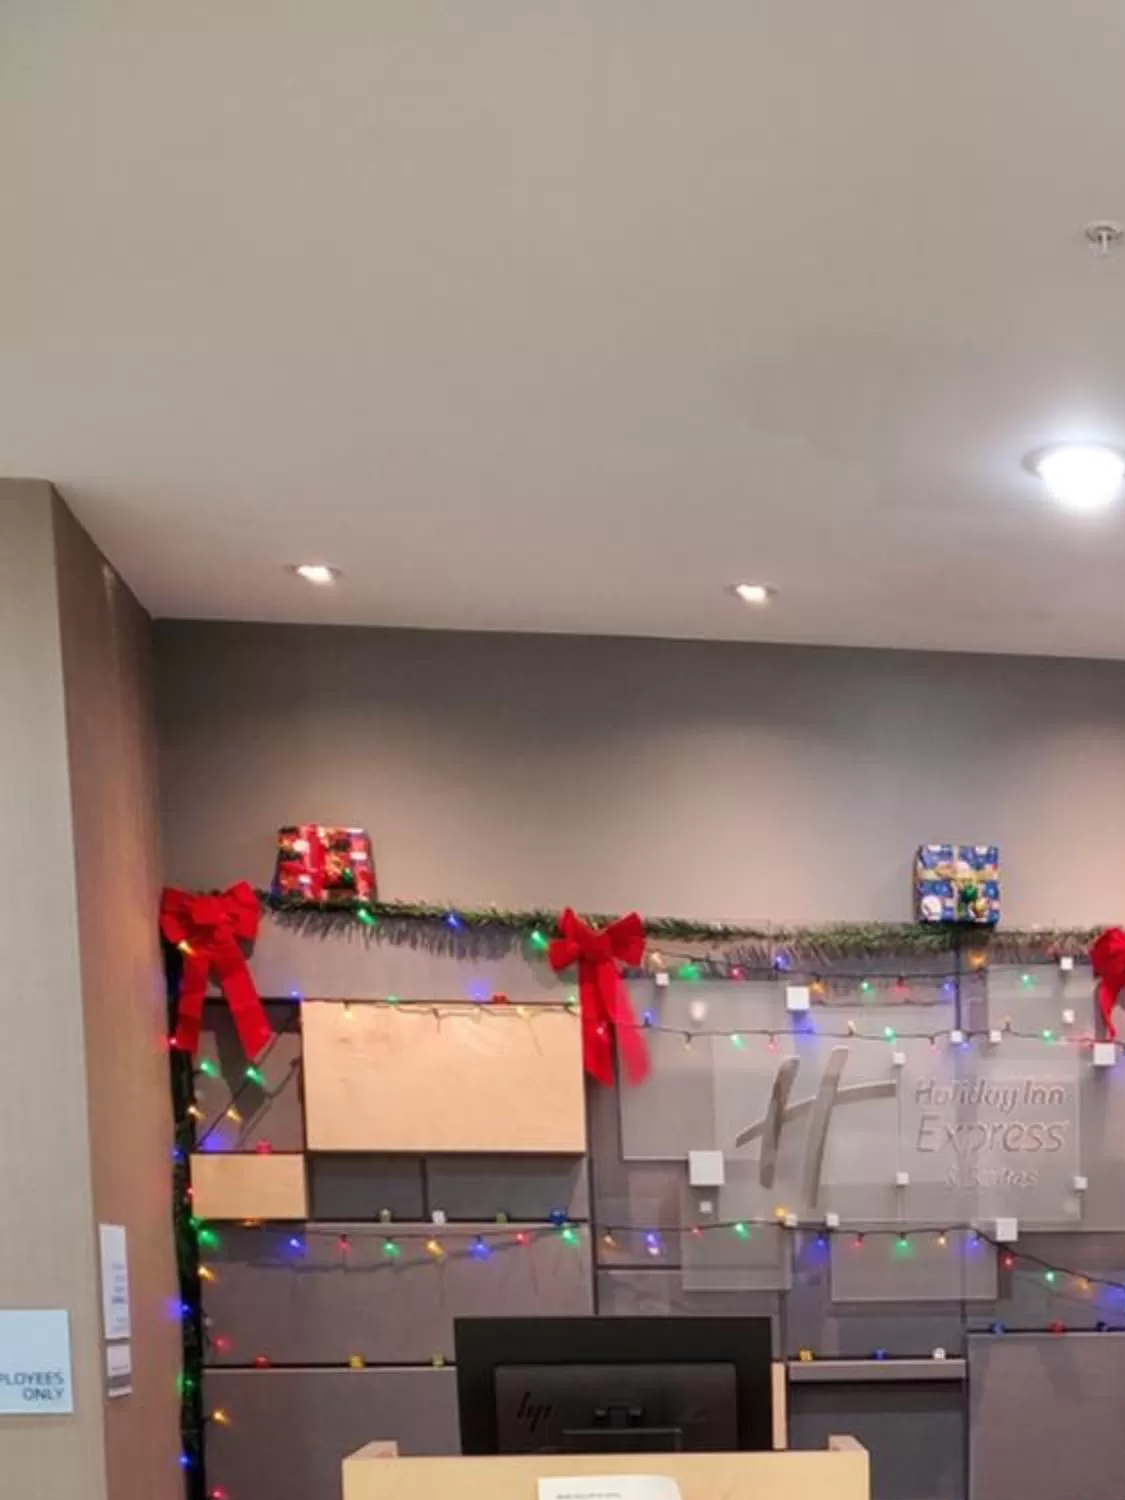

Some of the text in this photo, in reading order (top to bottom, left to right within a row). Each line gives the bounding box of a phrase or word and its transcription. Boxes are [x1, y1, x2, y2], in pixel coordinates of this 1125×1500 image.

[915, 1078, 1065, 1116] Holiday Inn
[916, 1113, 1066, 1158] Express
[22, 1387, 65, 1401] ONLY
[515, 1390, 553, 1435] hp
